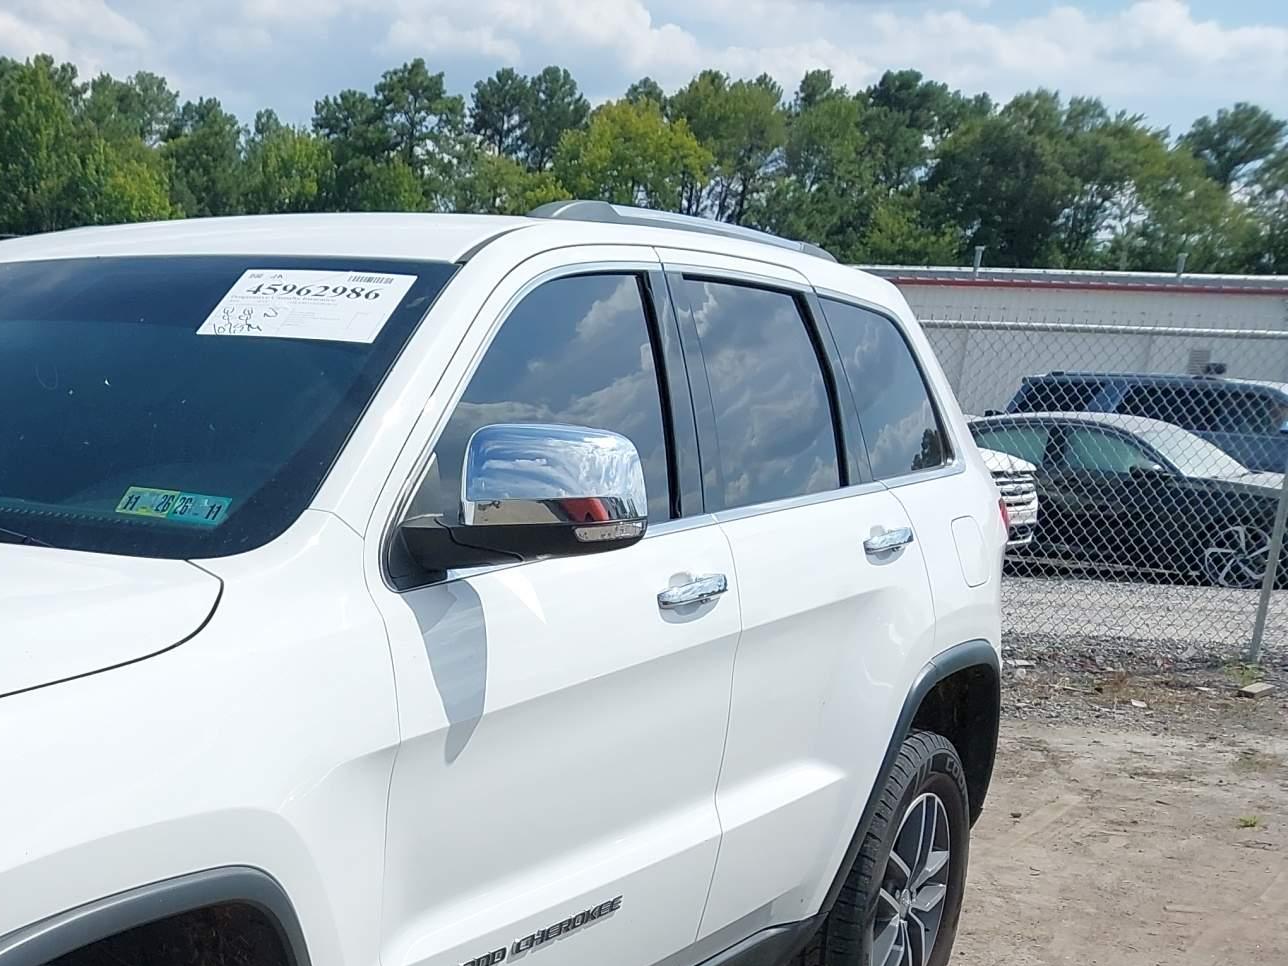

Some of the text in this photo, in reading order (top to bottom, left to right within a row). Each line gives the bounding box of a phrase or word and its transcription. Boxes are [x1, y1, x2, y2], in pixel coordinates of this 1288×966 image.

[246, 283, 384, 301] 45962986
[155, 494, 175, 514] 26
[173, 496, 192, 515] 26
[511, 895, 624, 955] CHEROKEE
